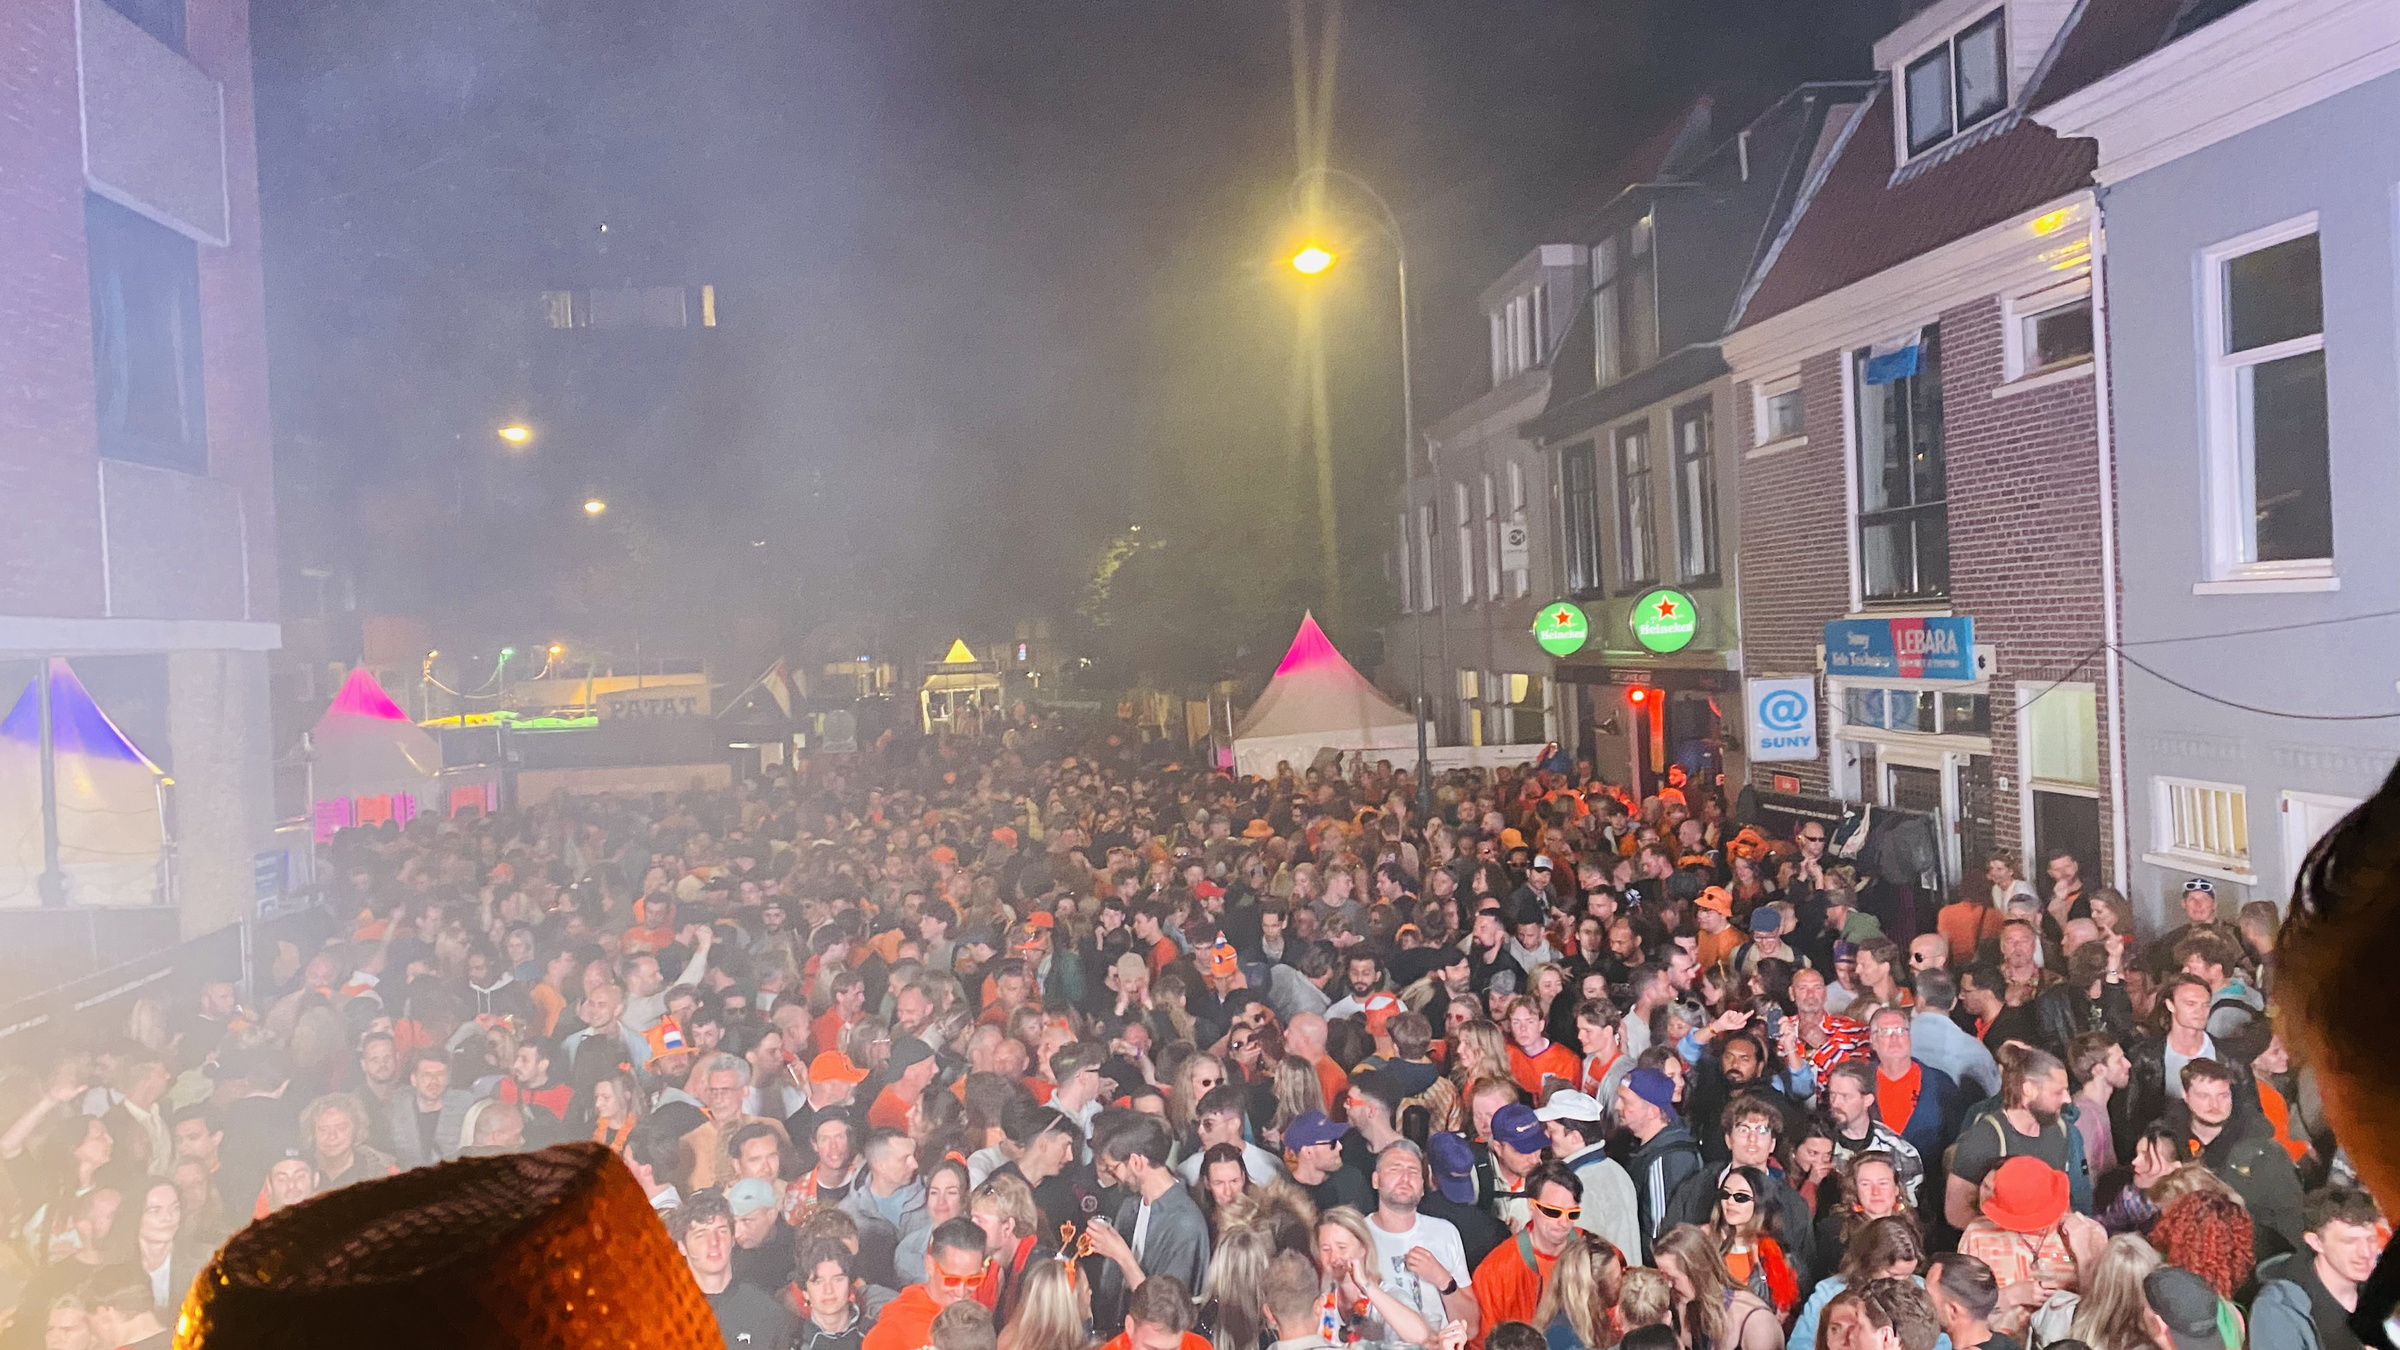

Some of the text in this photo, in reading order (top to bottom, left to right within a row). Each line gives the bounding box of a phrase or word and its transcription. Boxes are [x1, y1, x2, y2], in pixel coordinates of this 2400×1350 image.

[1541, 629, 1586, 640] Heineken
[1640, 621, 1693, 635] Heineken
[1897, 628, 1959, 655] LEBARA
[610, 697, 698, 719] PATAT
[1760, 735, 1812, 749] SUNY
